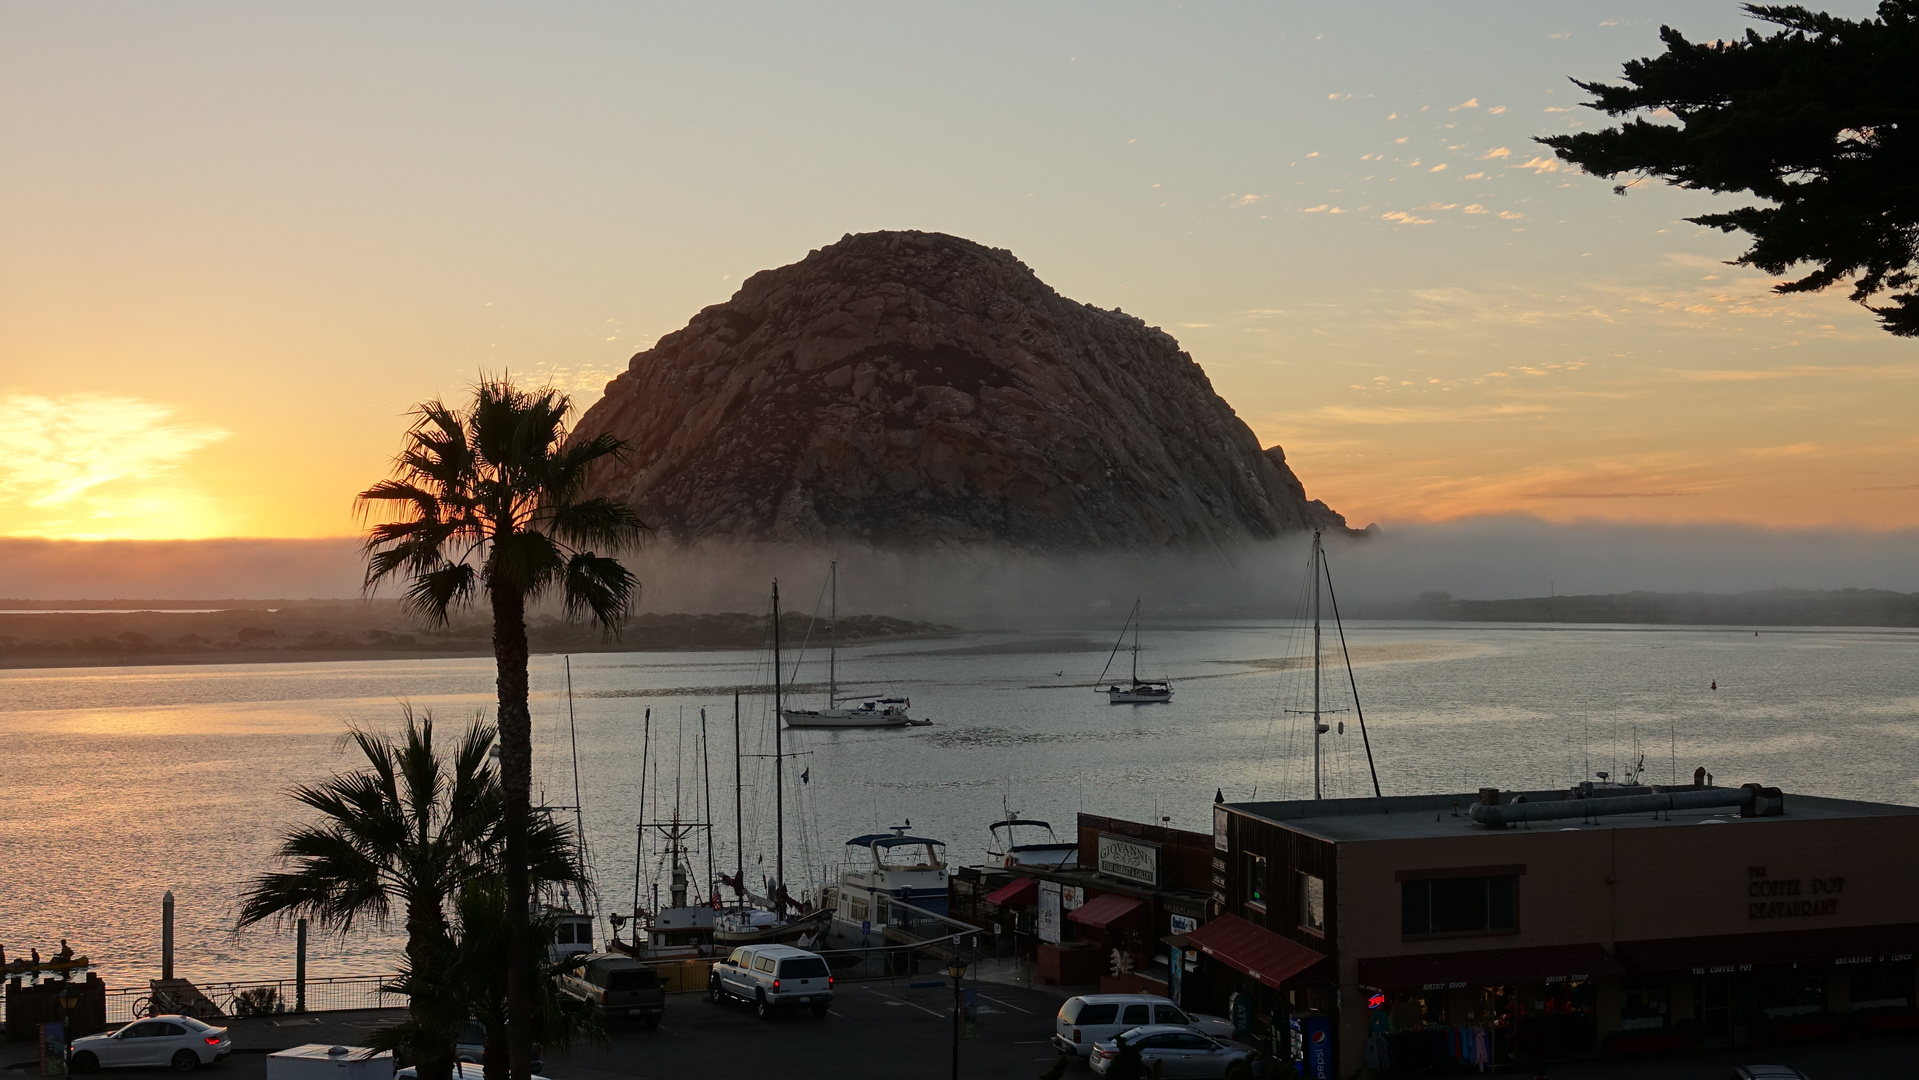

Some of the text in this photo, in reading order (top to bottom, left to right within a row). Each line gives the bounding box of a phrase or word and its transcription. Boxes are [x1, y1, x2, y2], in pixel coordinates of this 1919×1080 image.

[1100, 843, 1155, 871] GIOVANNI'S
[1749, 877, 1844, 897] COFFEE POT
[1749, 899, 1838, 919] RESTAURANT
[1835, 956, 1872, 965] BREAKFAST
[1891, 953, 1912, 962] LUNCH
[1546, 975, 1567, 983] SHIRT
[1692, 964, 1752, 975] THE COFFEE POT
[1422, 983, 1445, 991] SHIRT
[1237, 1004, 1248, 1031] ATM
[1314, 1048, 1327, 1080] pepsi
